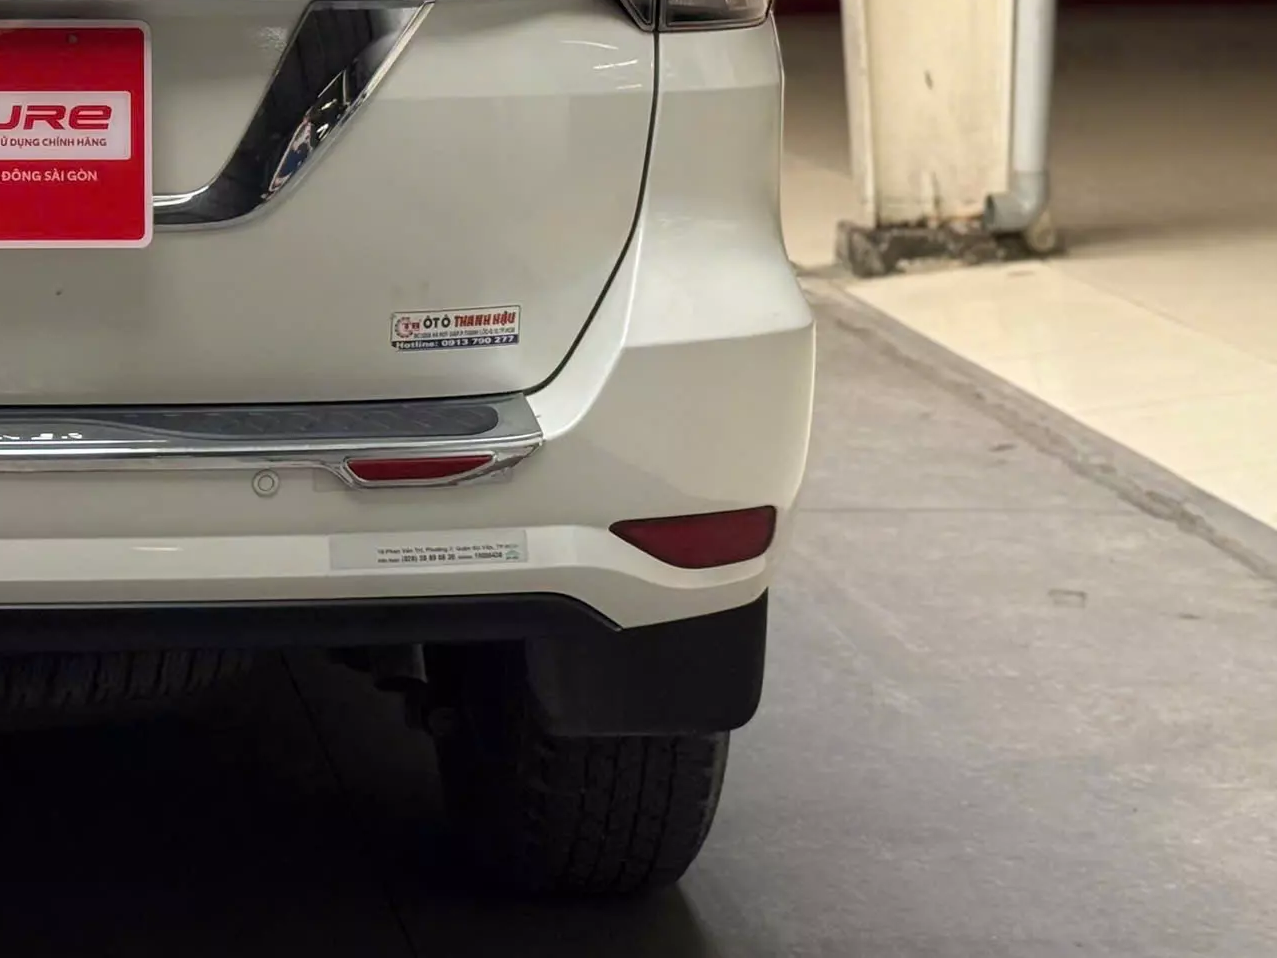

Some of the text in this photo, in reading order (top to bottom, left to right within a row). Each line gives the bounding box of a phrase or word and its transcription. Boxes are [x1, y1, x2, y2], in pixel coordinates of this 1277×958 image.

[10, 138, 40, 149] DỤNG
[42, 136, 75, 147] CHÍNH
[1, 168, 42, 182] ĐÔNG
[44, 168, 64, 182] SÀI
[67, 168, 98, 182] GÒN
[454, 314, 492, 327] THANH
[495, 335, 515, 343] 277
